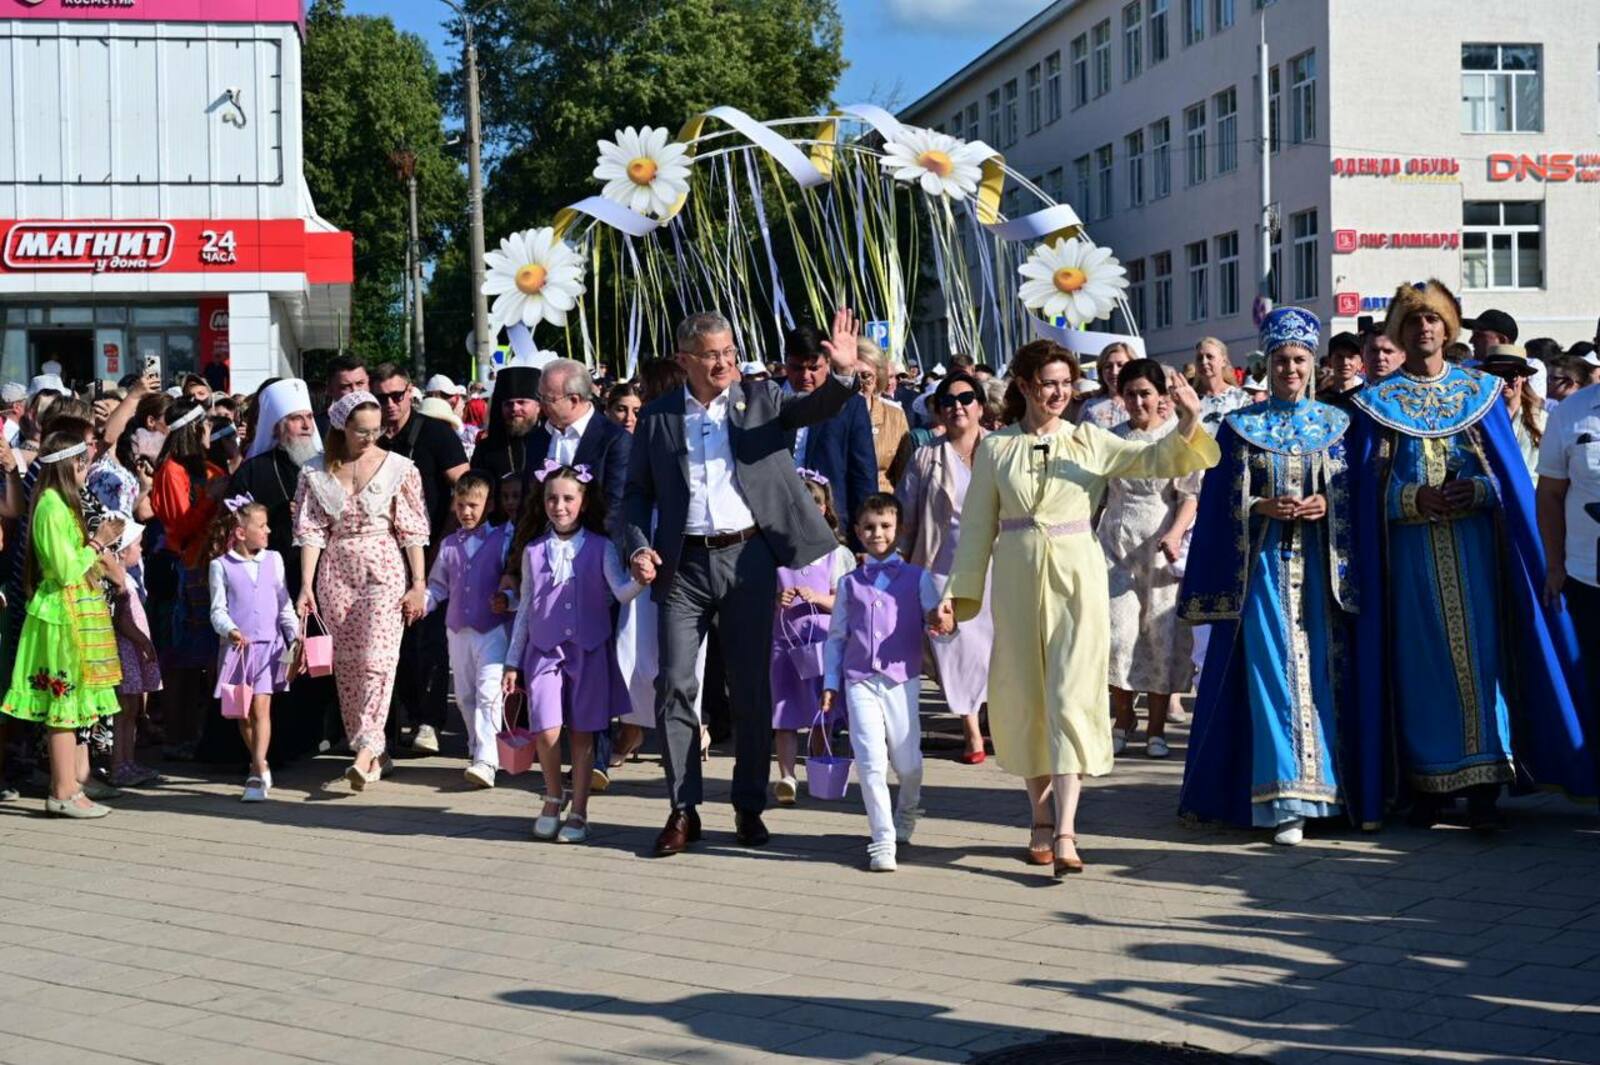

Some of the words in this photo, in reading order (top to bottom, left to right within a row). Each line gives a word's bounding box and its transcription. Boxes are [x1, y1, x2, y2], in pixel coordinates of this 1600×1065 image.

[1332, 157, 1401, 176] ОДЕЖДА
[1408, 157, 1460, 174] ОБУВЬ
[1490, 153, 1576, 179] DNS
[15, 232, 166, 257] МАГНИТ
[201, 230, 237, 252] 24
[1391, 233, 1460, 249] ЛОМБАРД
[96, 258, 108, 272] у
[110, 257, 149, 269] дома
[201, 251, 237, 263] ЧАСА
